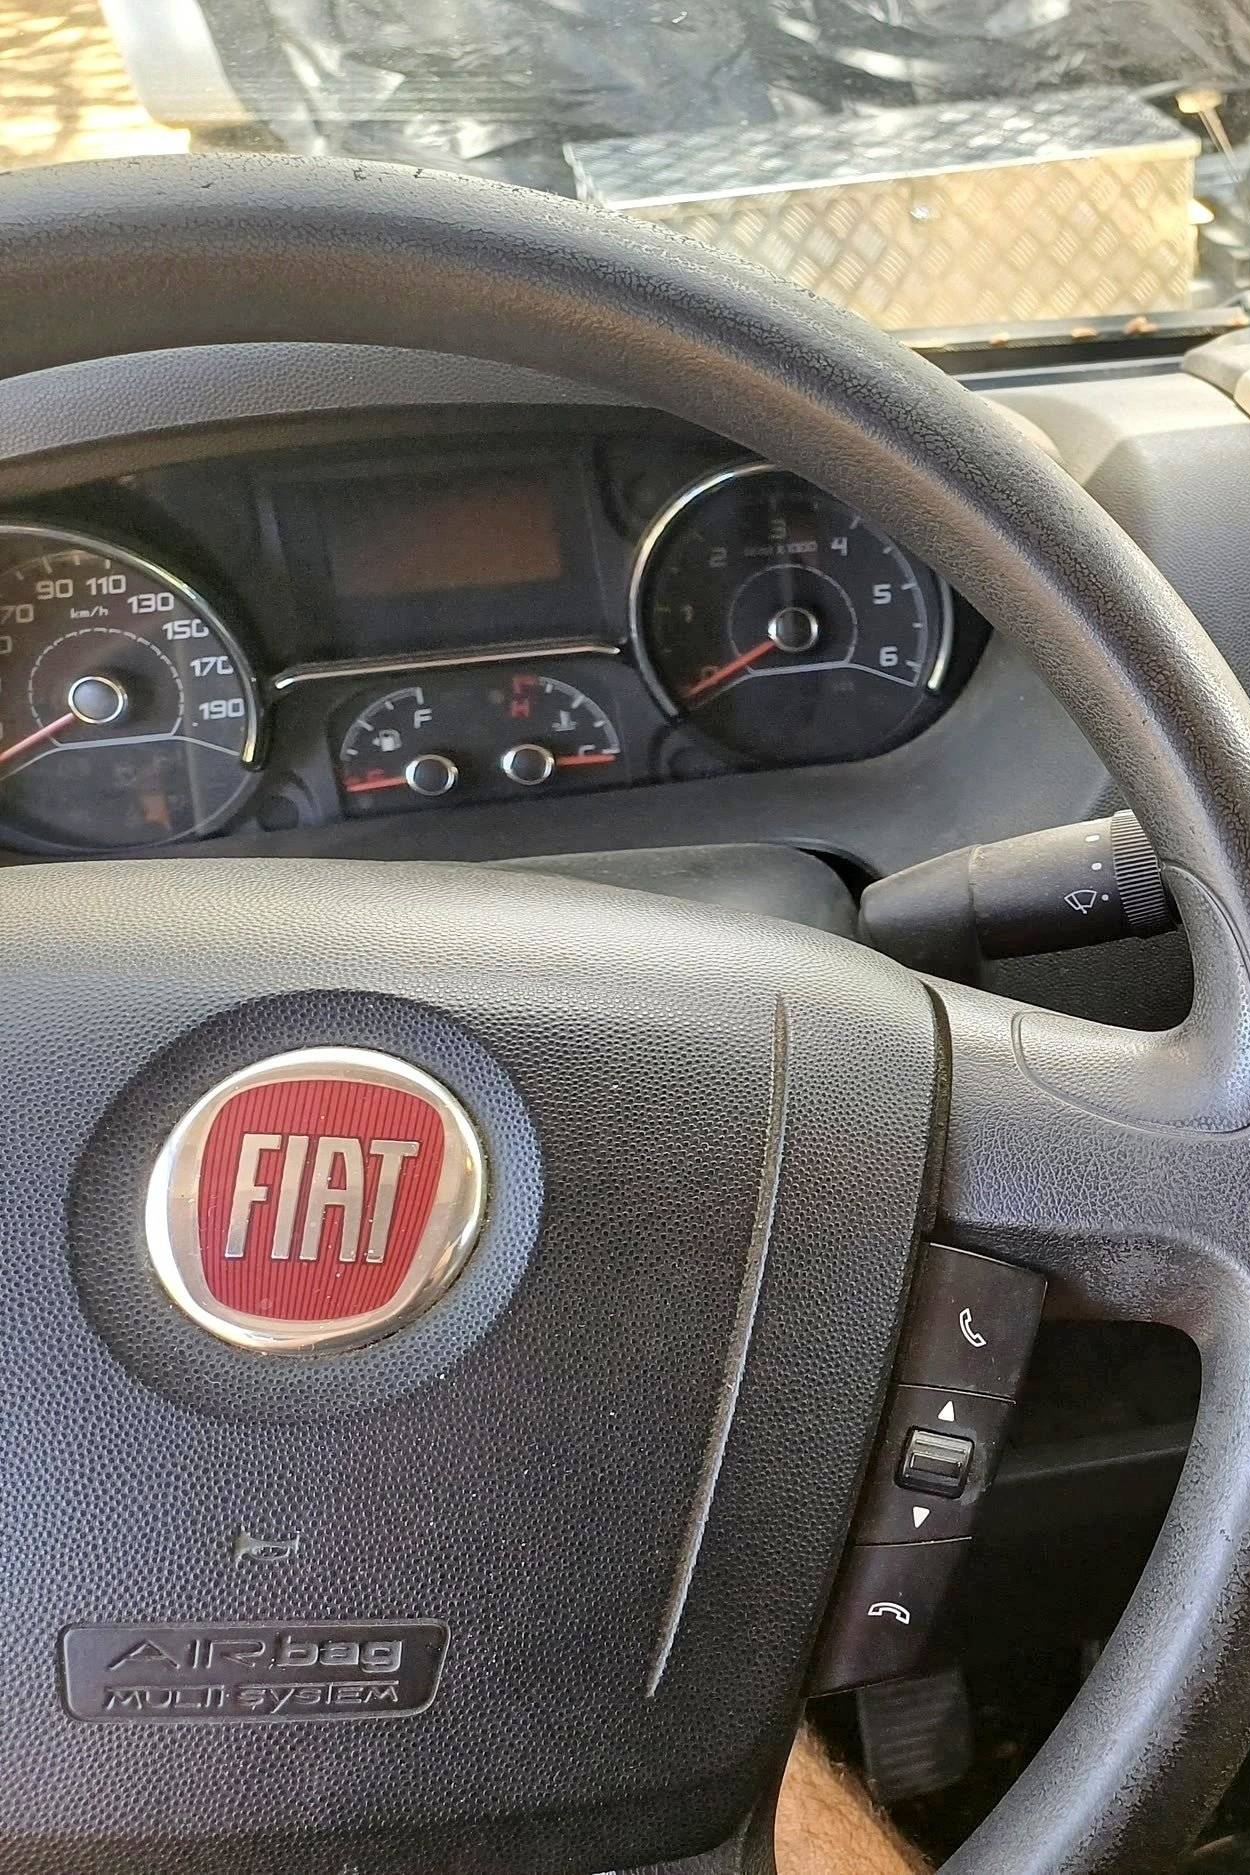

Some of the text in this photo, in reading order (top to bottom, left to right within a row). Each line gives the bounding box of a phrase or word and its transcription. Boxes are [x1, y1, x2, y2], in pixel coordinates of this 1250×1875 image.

[831, 536, 848, 556] 4
[36, 579, 74, 600] 90
[86, 574, 126, 596] 110
[873, 584, 891, 605] 5
[70, 606, 109, 619] km/h
[128, 592, 174, 613] 130
[162, 618, 209, 640] 150
[190, 656, 234, 676] 170
[879, 646, 898, 667] 6
[199, 698, 244, 720] 190
[413, 708, 432, 729] F
[224, 1133, 421, 1264] FIAT
